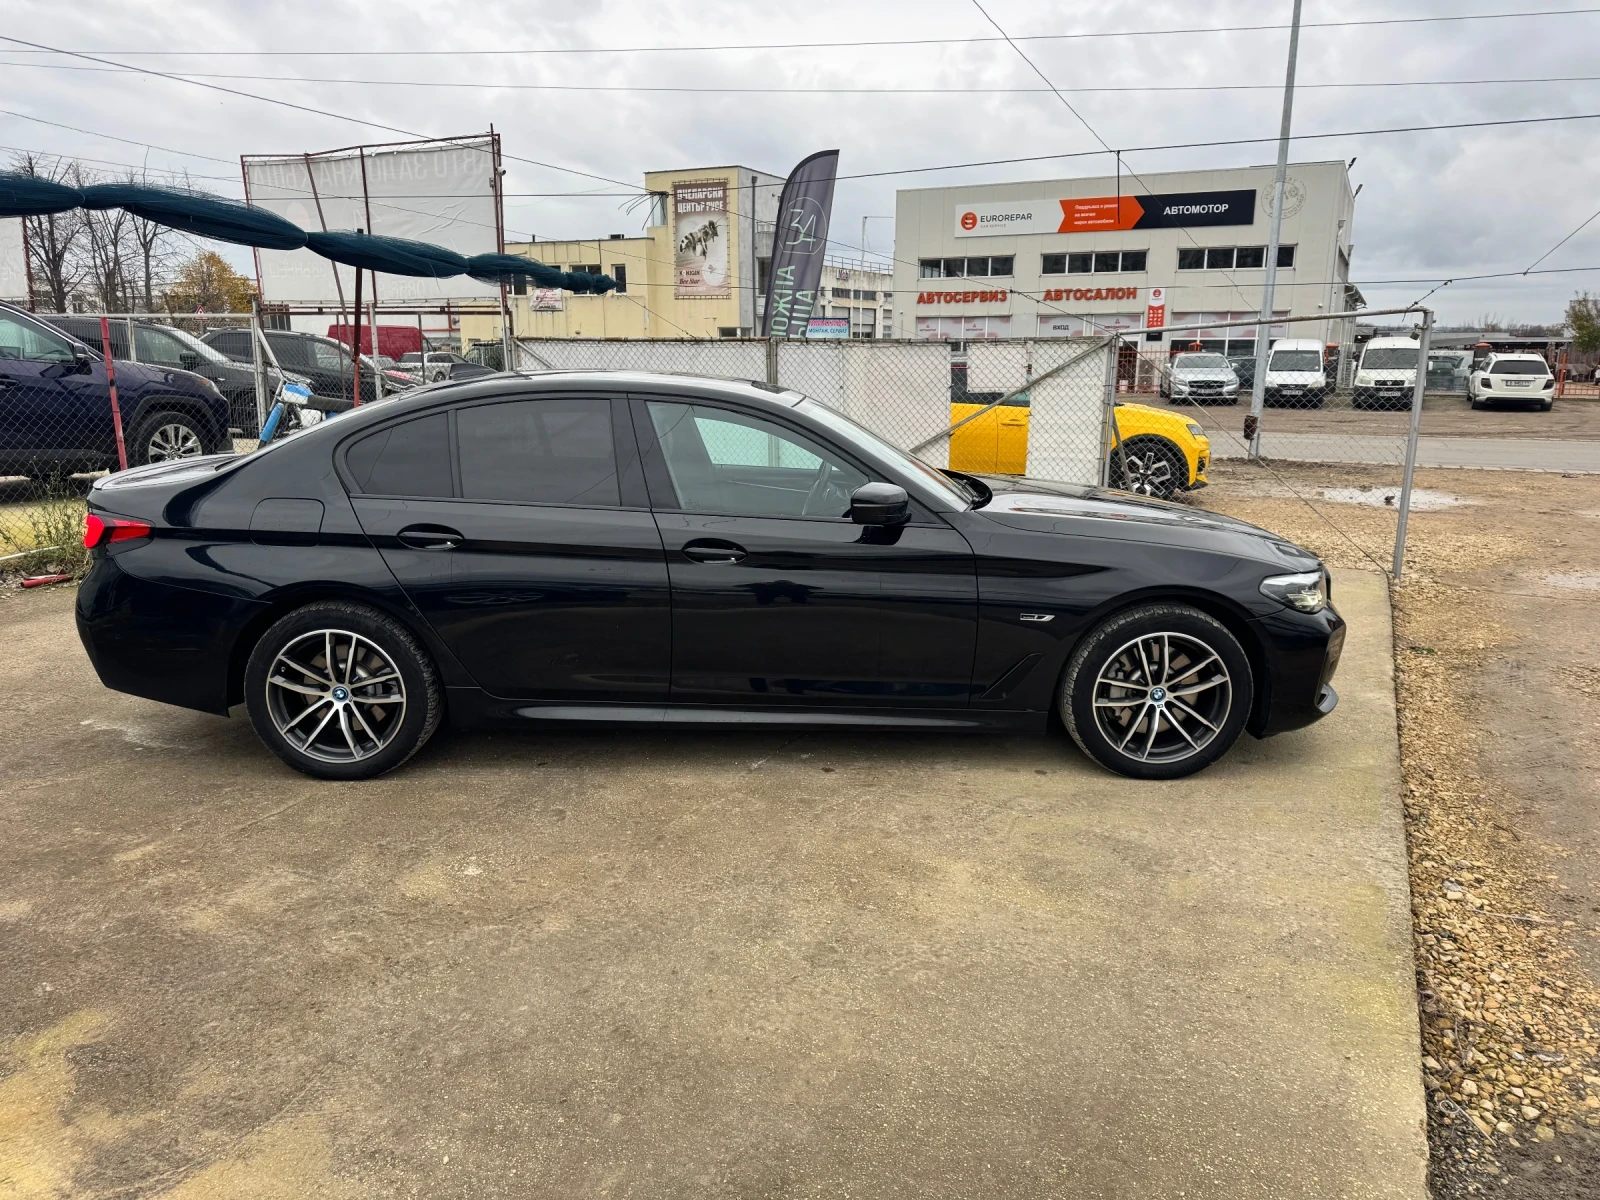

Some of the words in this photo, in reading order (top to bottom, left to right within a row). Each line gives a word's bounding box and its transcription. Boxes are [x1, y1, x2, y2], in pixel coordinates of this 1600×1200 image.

[676, 186, 724, 200] ПЧЕЛАРСКИ
[677, 202, 705, 214] ЦЕНТЪР
[706, 200, 724, 212] РУСЕ
[1163, 203, 1229, 216] АВТОМОТОР
[980, 213, 1033, 223] EUROREPAR
[916, 289, 1008, 305] АВТОСЕРВИЗ
[1043, 286, 1138, 302] АВТОСАЛОН
